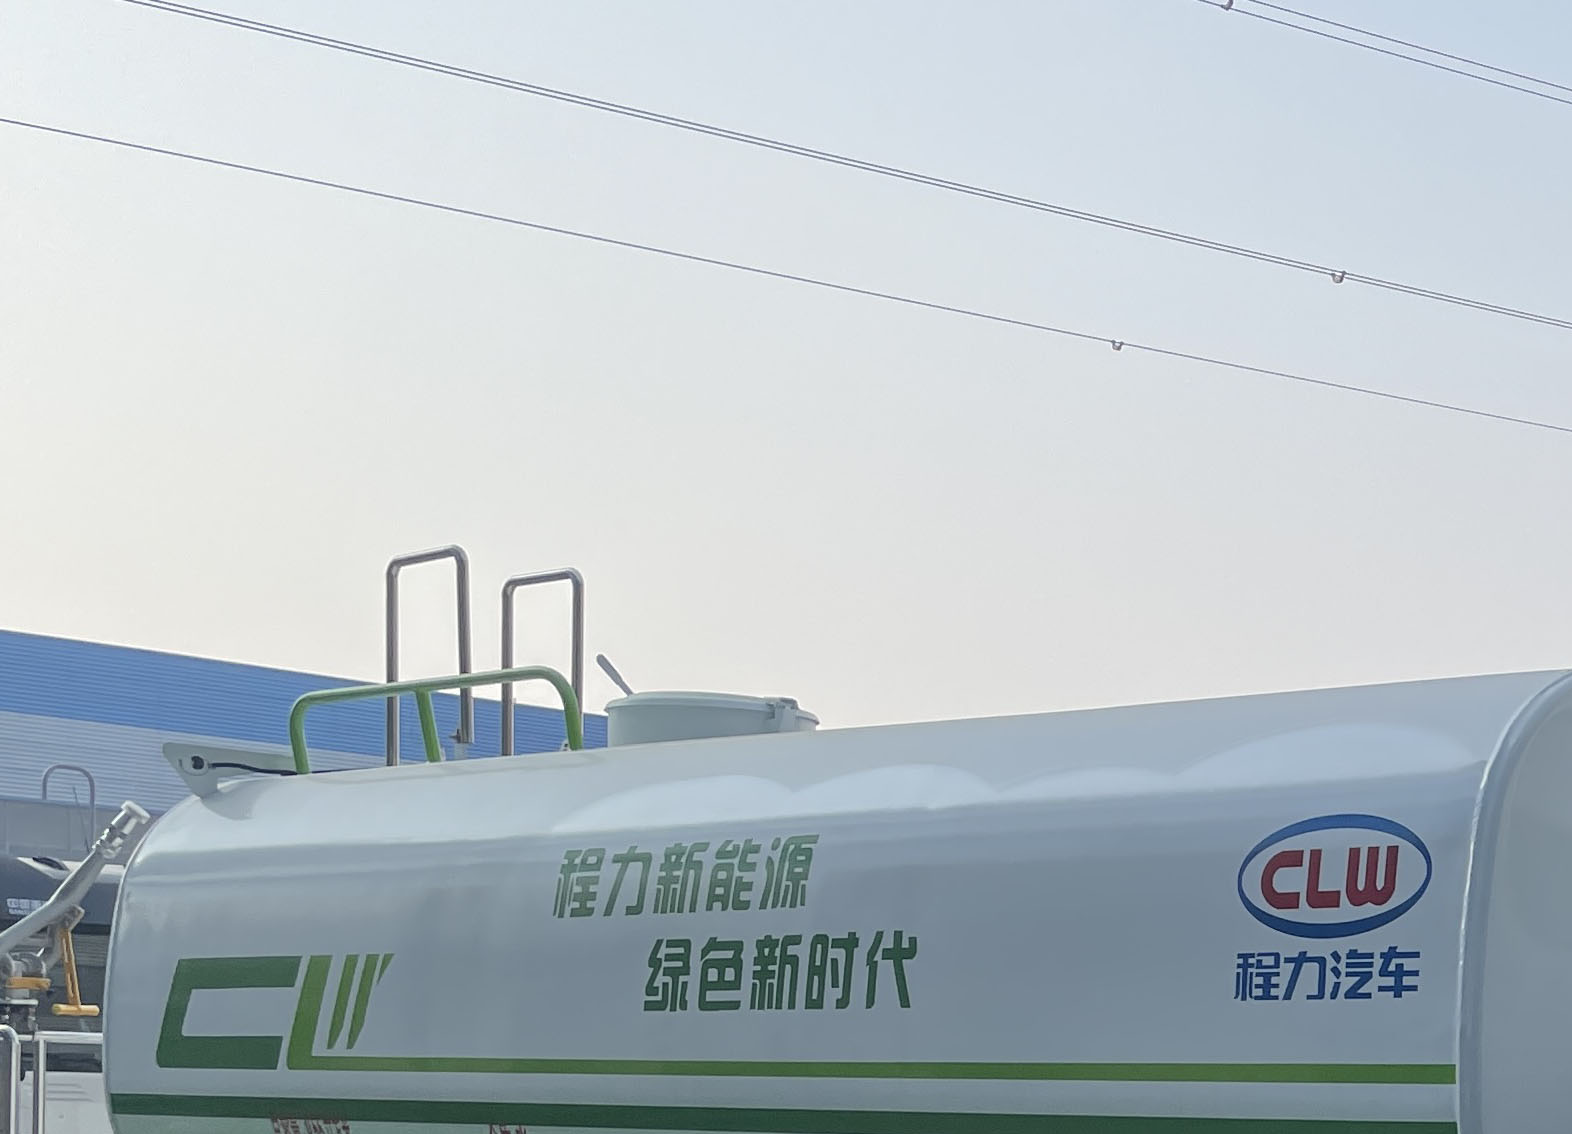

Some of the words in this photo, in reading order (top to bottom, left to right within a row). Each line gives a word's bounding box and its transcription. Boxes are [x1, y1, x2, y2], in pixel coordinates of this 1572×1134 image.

[553, 834, 819, 918] 程力新能源
[1261, 845, 1399, 910] CLW
[643, 931, 918, 1012] 绿色新时代
[1234, 946, 1421, 1002] 程力汽车
